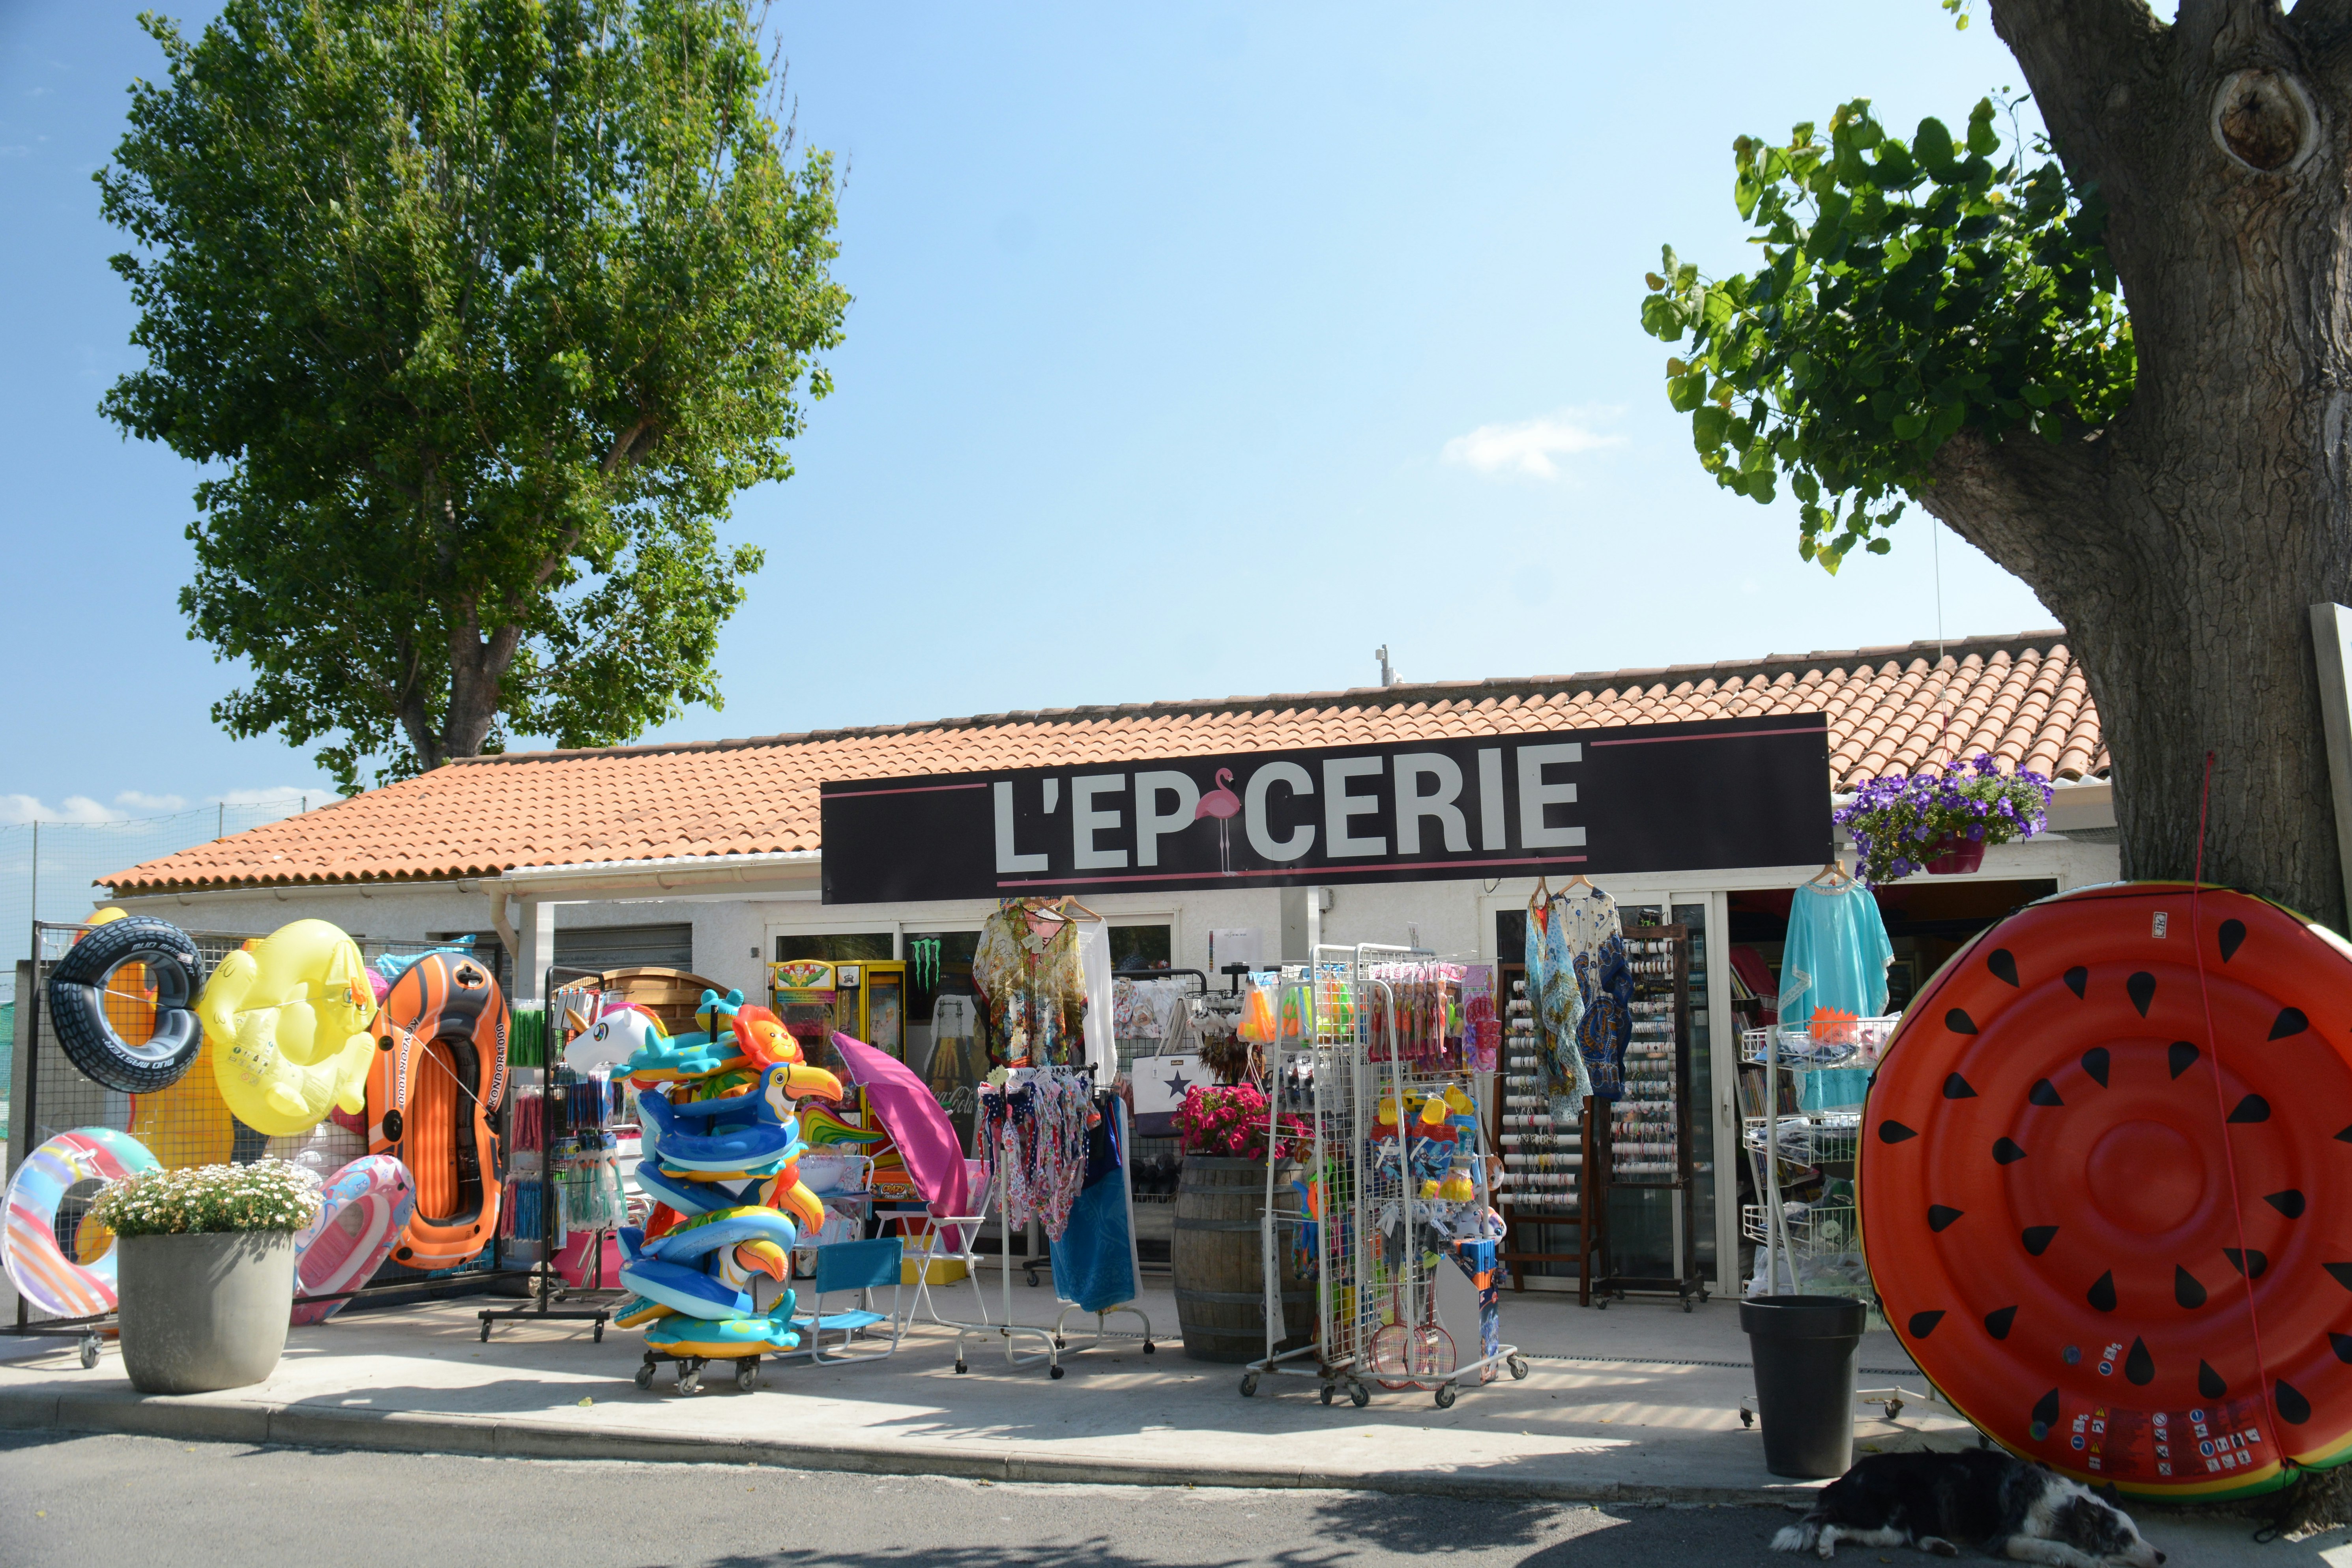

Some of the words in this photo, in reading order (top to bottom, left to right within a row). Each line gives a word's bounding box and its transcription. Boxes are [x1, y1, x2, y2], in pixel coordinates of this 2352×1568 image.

[131, 942, 157, 951] MUD
[159, 943, 195, 975] MASR
[399, 1017, 420, 1070] KONDOR
[495, 1023, 506, 1053] 1000
[104, 1040, 150, 1068] MASTER
[152, 1057, 174, 1069] MUD
[398, 1072, 406, 1104] 1000
[487, 1053, 505, 1107] KONDOR
[882, 1184, 906, 1194] CRAZY
